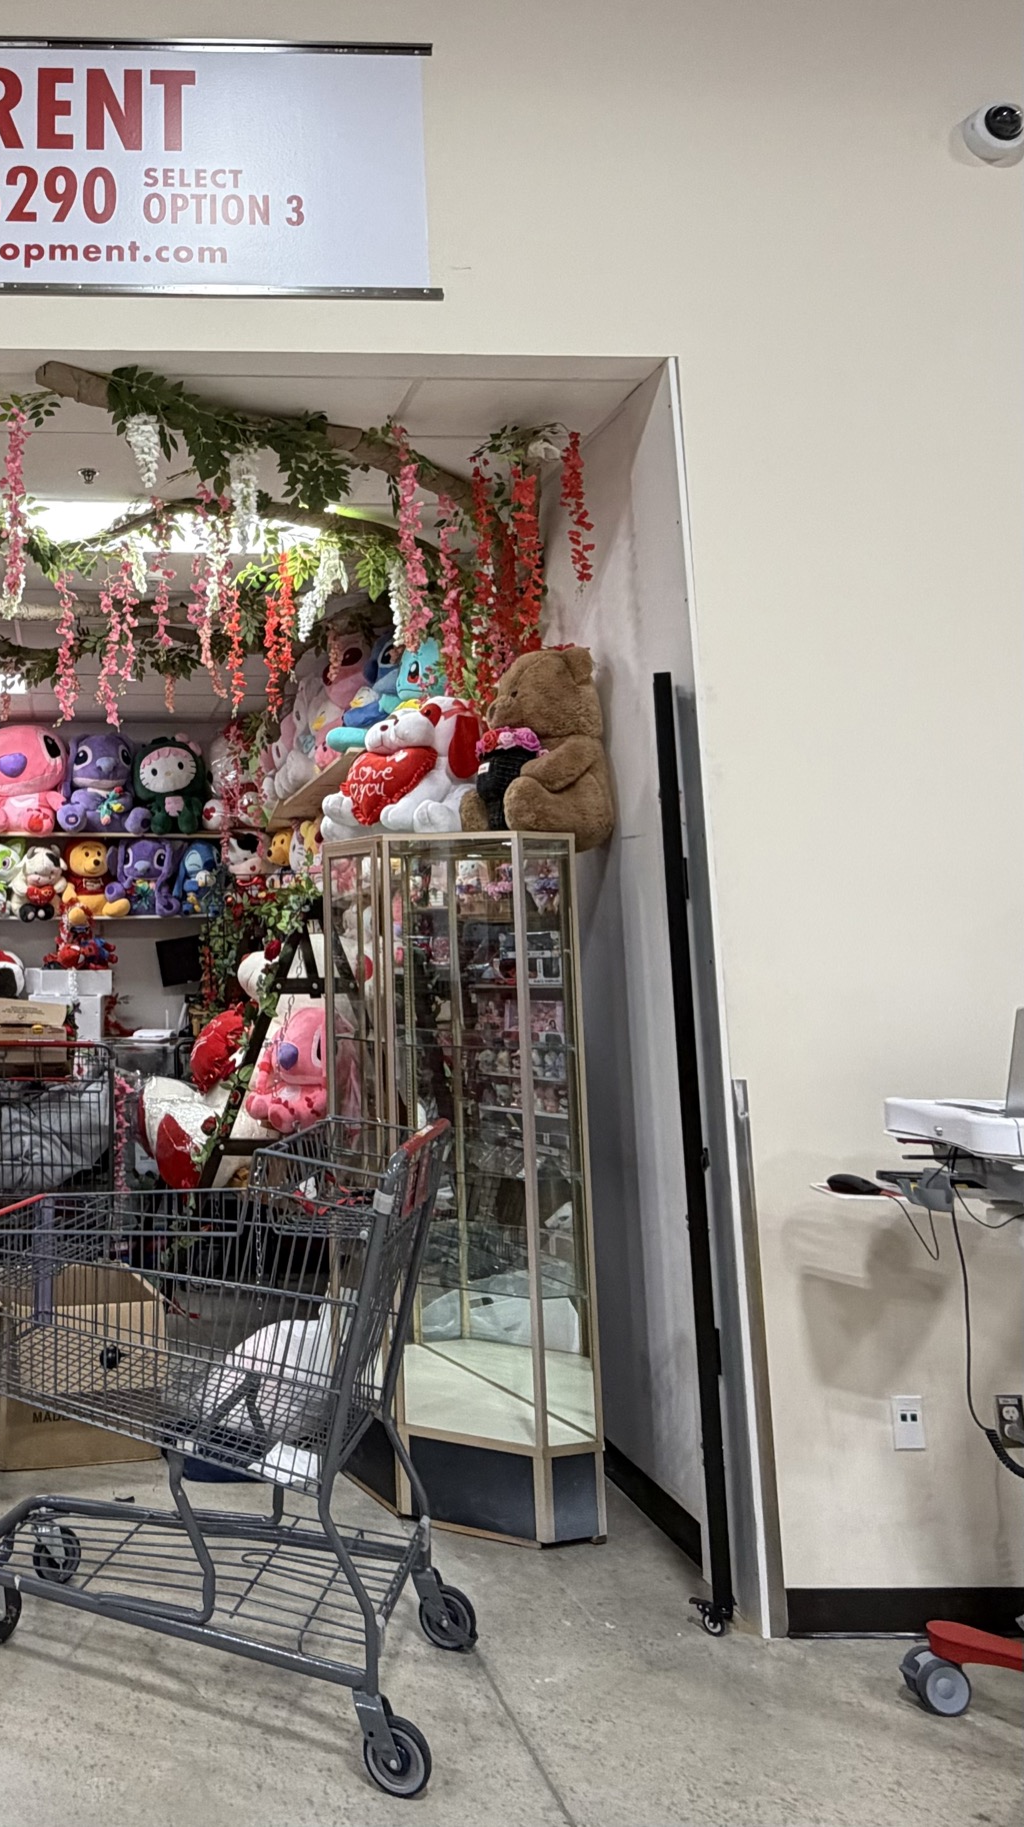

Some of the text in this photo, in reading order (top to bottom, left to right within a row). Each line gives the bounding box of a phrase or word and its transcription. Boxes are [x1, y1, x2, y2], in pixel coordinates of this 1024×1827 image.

[143, 168, 242, 190] SELECT
[142, 193, 305, 226] OPTION 3
